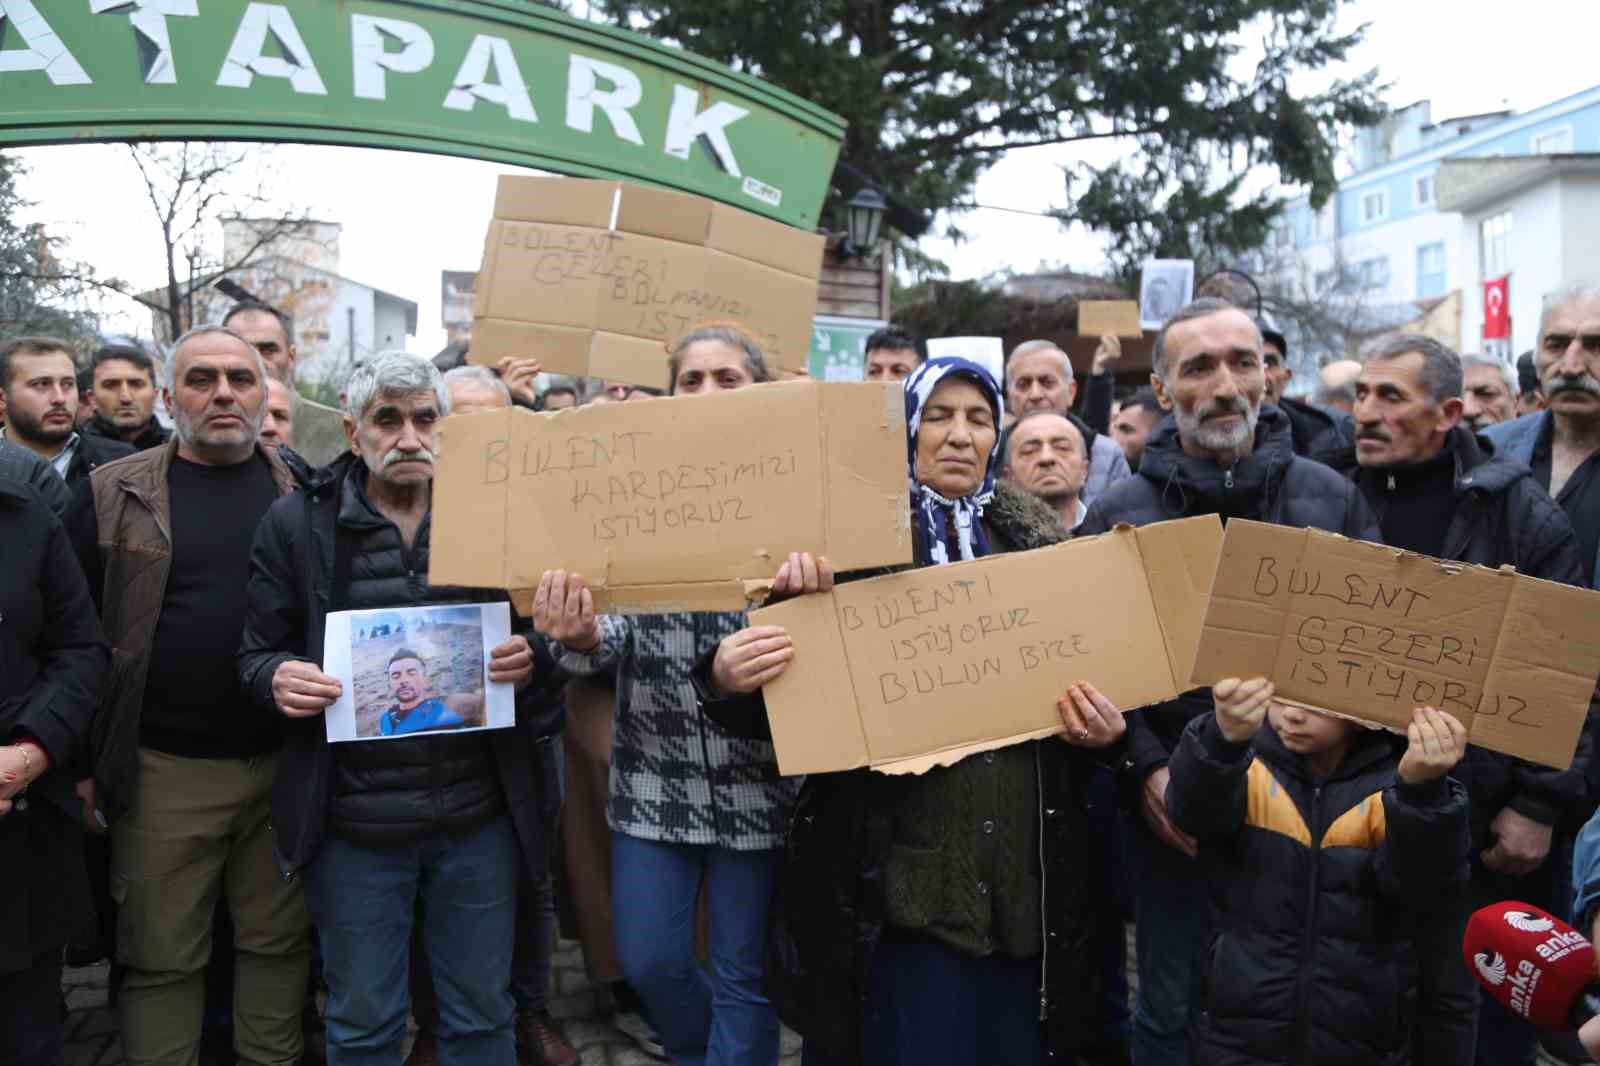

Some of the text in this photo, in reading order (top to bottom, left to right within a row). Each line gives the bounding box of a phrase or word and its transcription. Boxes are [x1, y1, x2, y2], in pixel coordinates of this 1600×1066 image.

[1296, 615, 1480, 667] GEZERİ
[880, 633, 1092, 705] BULUN BİZE
[1289, 657, 1545, 729] İSTİYORUZ
[1535, 930, 1588, 958] anka
[1507, 959, 1536, 1014] anka
